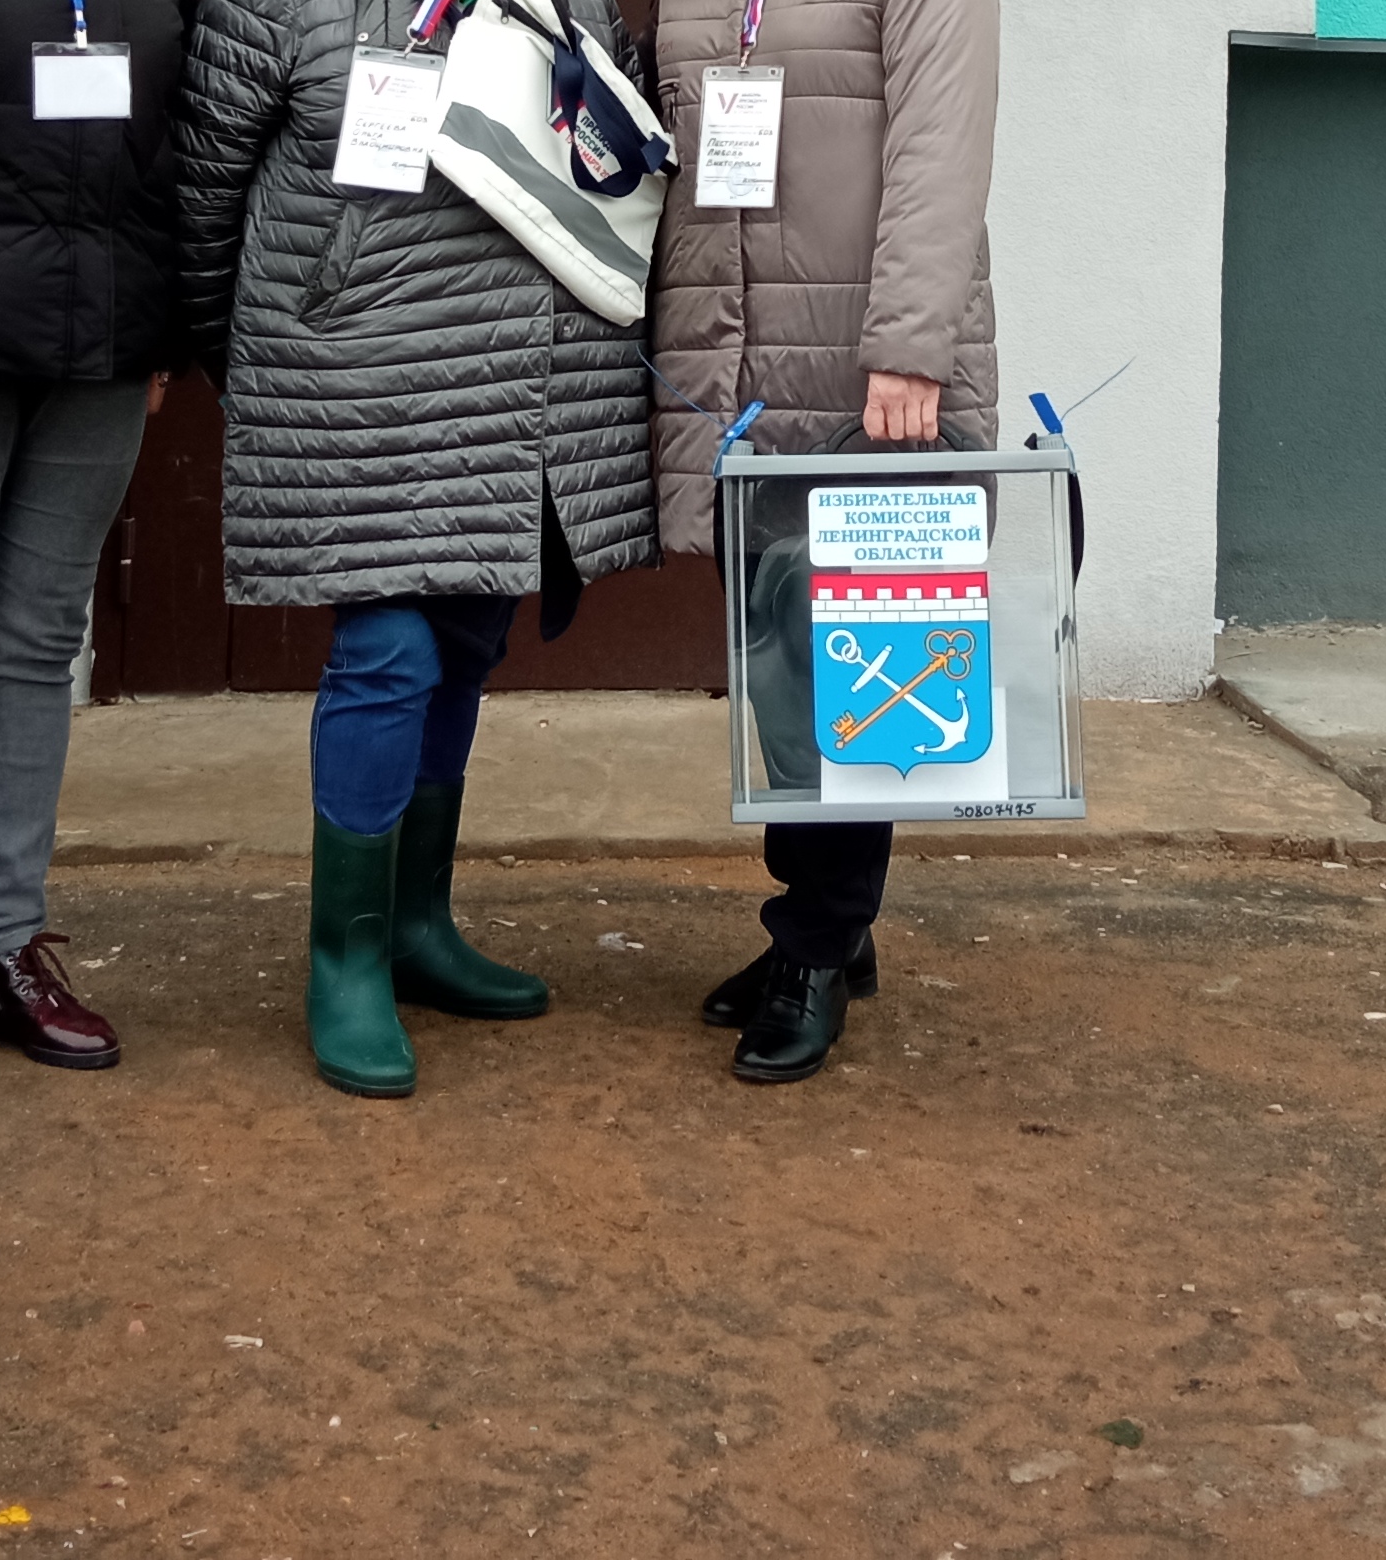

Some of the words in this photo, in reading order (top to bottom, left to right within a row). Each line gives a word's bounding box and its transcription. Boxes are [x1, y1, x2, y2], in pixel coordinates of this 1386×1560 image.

[576, 125, 606, 161] РОССИИ
[582, 150, 602, 173] МАРТА
[818, 492, 977, 507] ИЗБИРАТЕЛЬНАЯ
[844, 510, 951, 525] КОМИССИЯ
[815, 524, 981, 544] ЛЕНИНГРАДСКОЙ
[854, 546, 943, 561] ОБЛАСТИ
[953, 802, 1037, 818] 30807475
